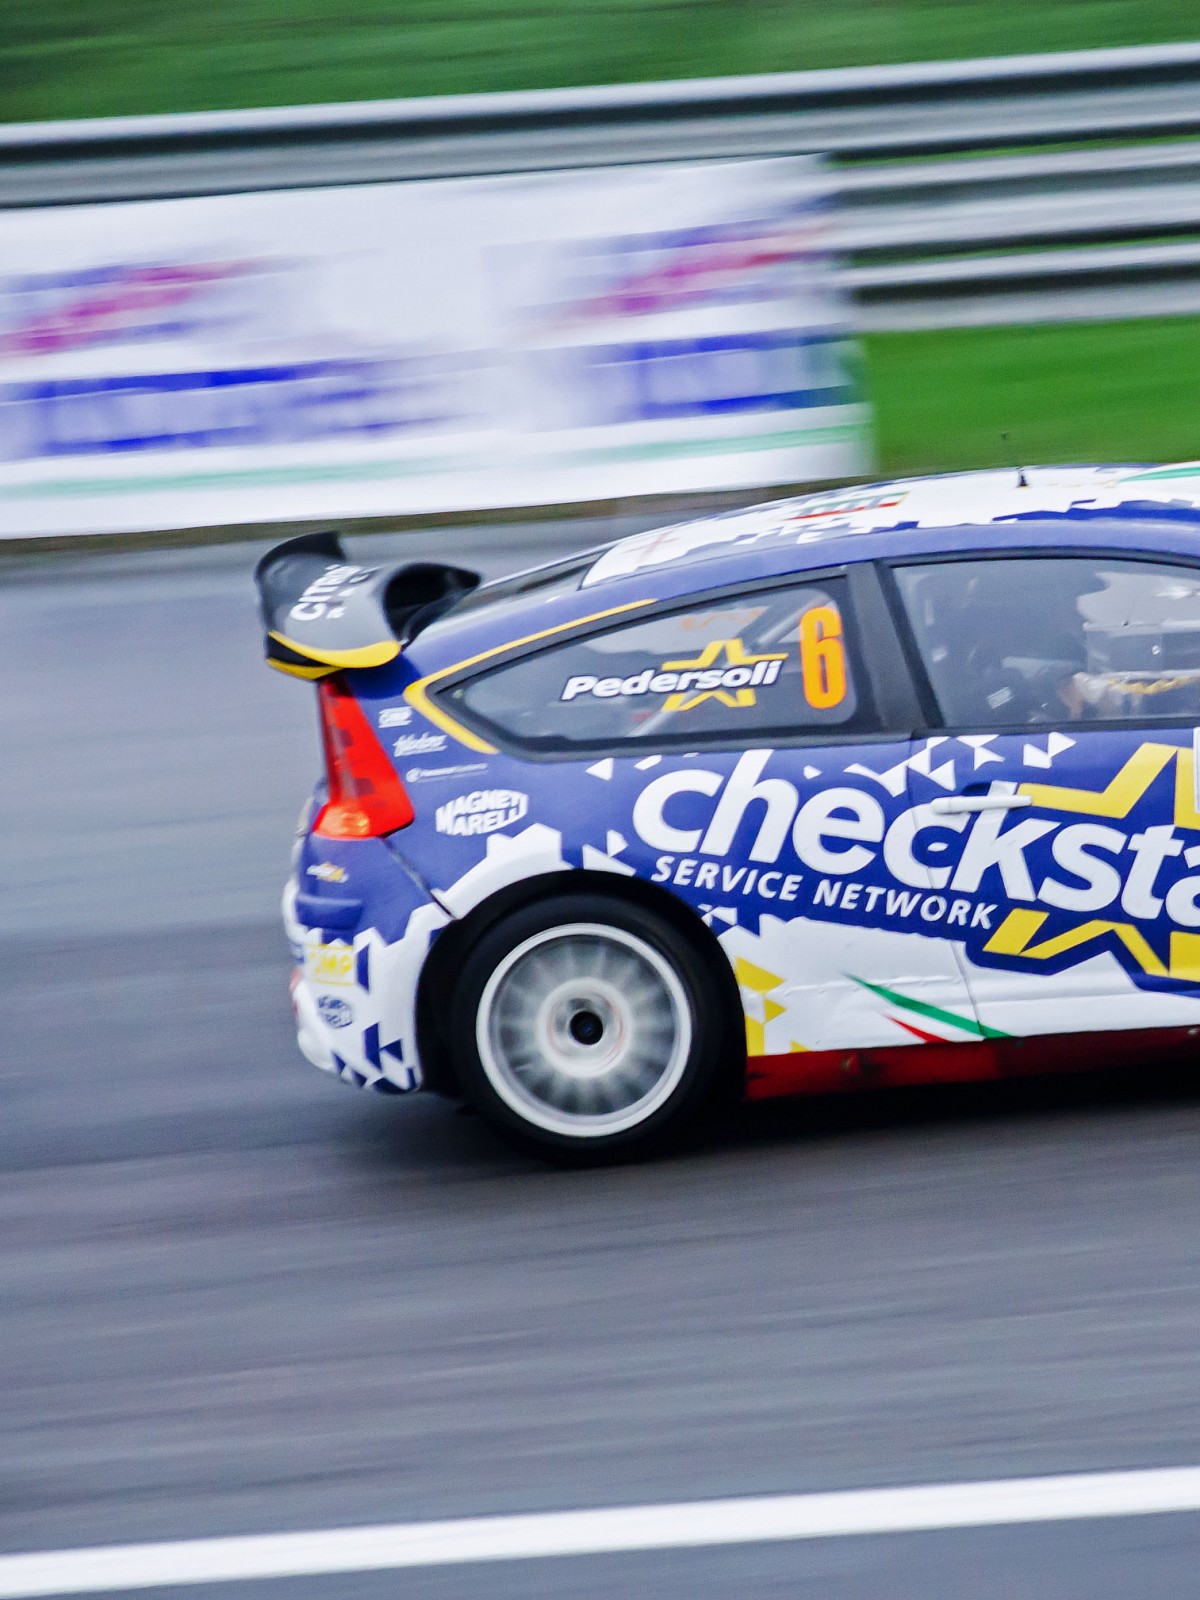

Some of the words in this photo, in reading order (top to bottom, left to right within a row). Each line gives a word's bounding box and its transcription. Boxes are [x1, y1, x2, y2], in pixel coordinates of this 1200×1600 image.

[561, 660, 784, 700] Pedersoli
[800, 606, 848, 709] 6
[650, 854, 803, 902] SERVICE
[812, 879, 998, 931] NETWORK
